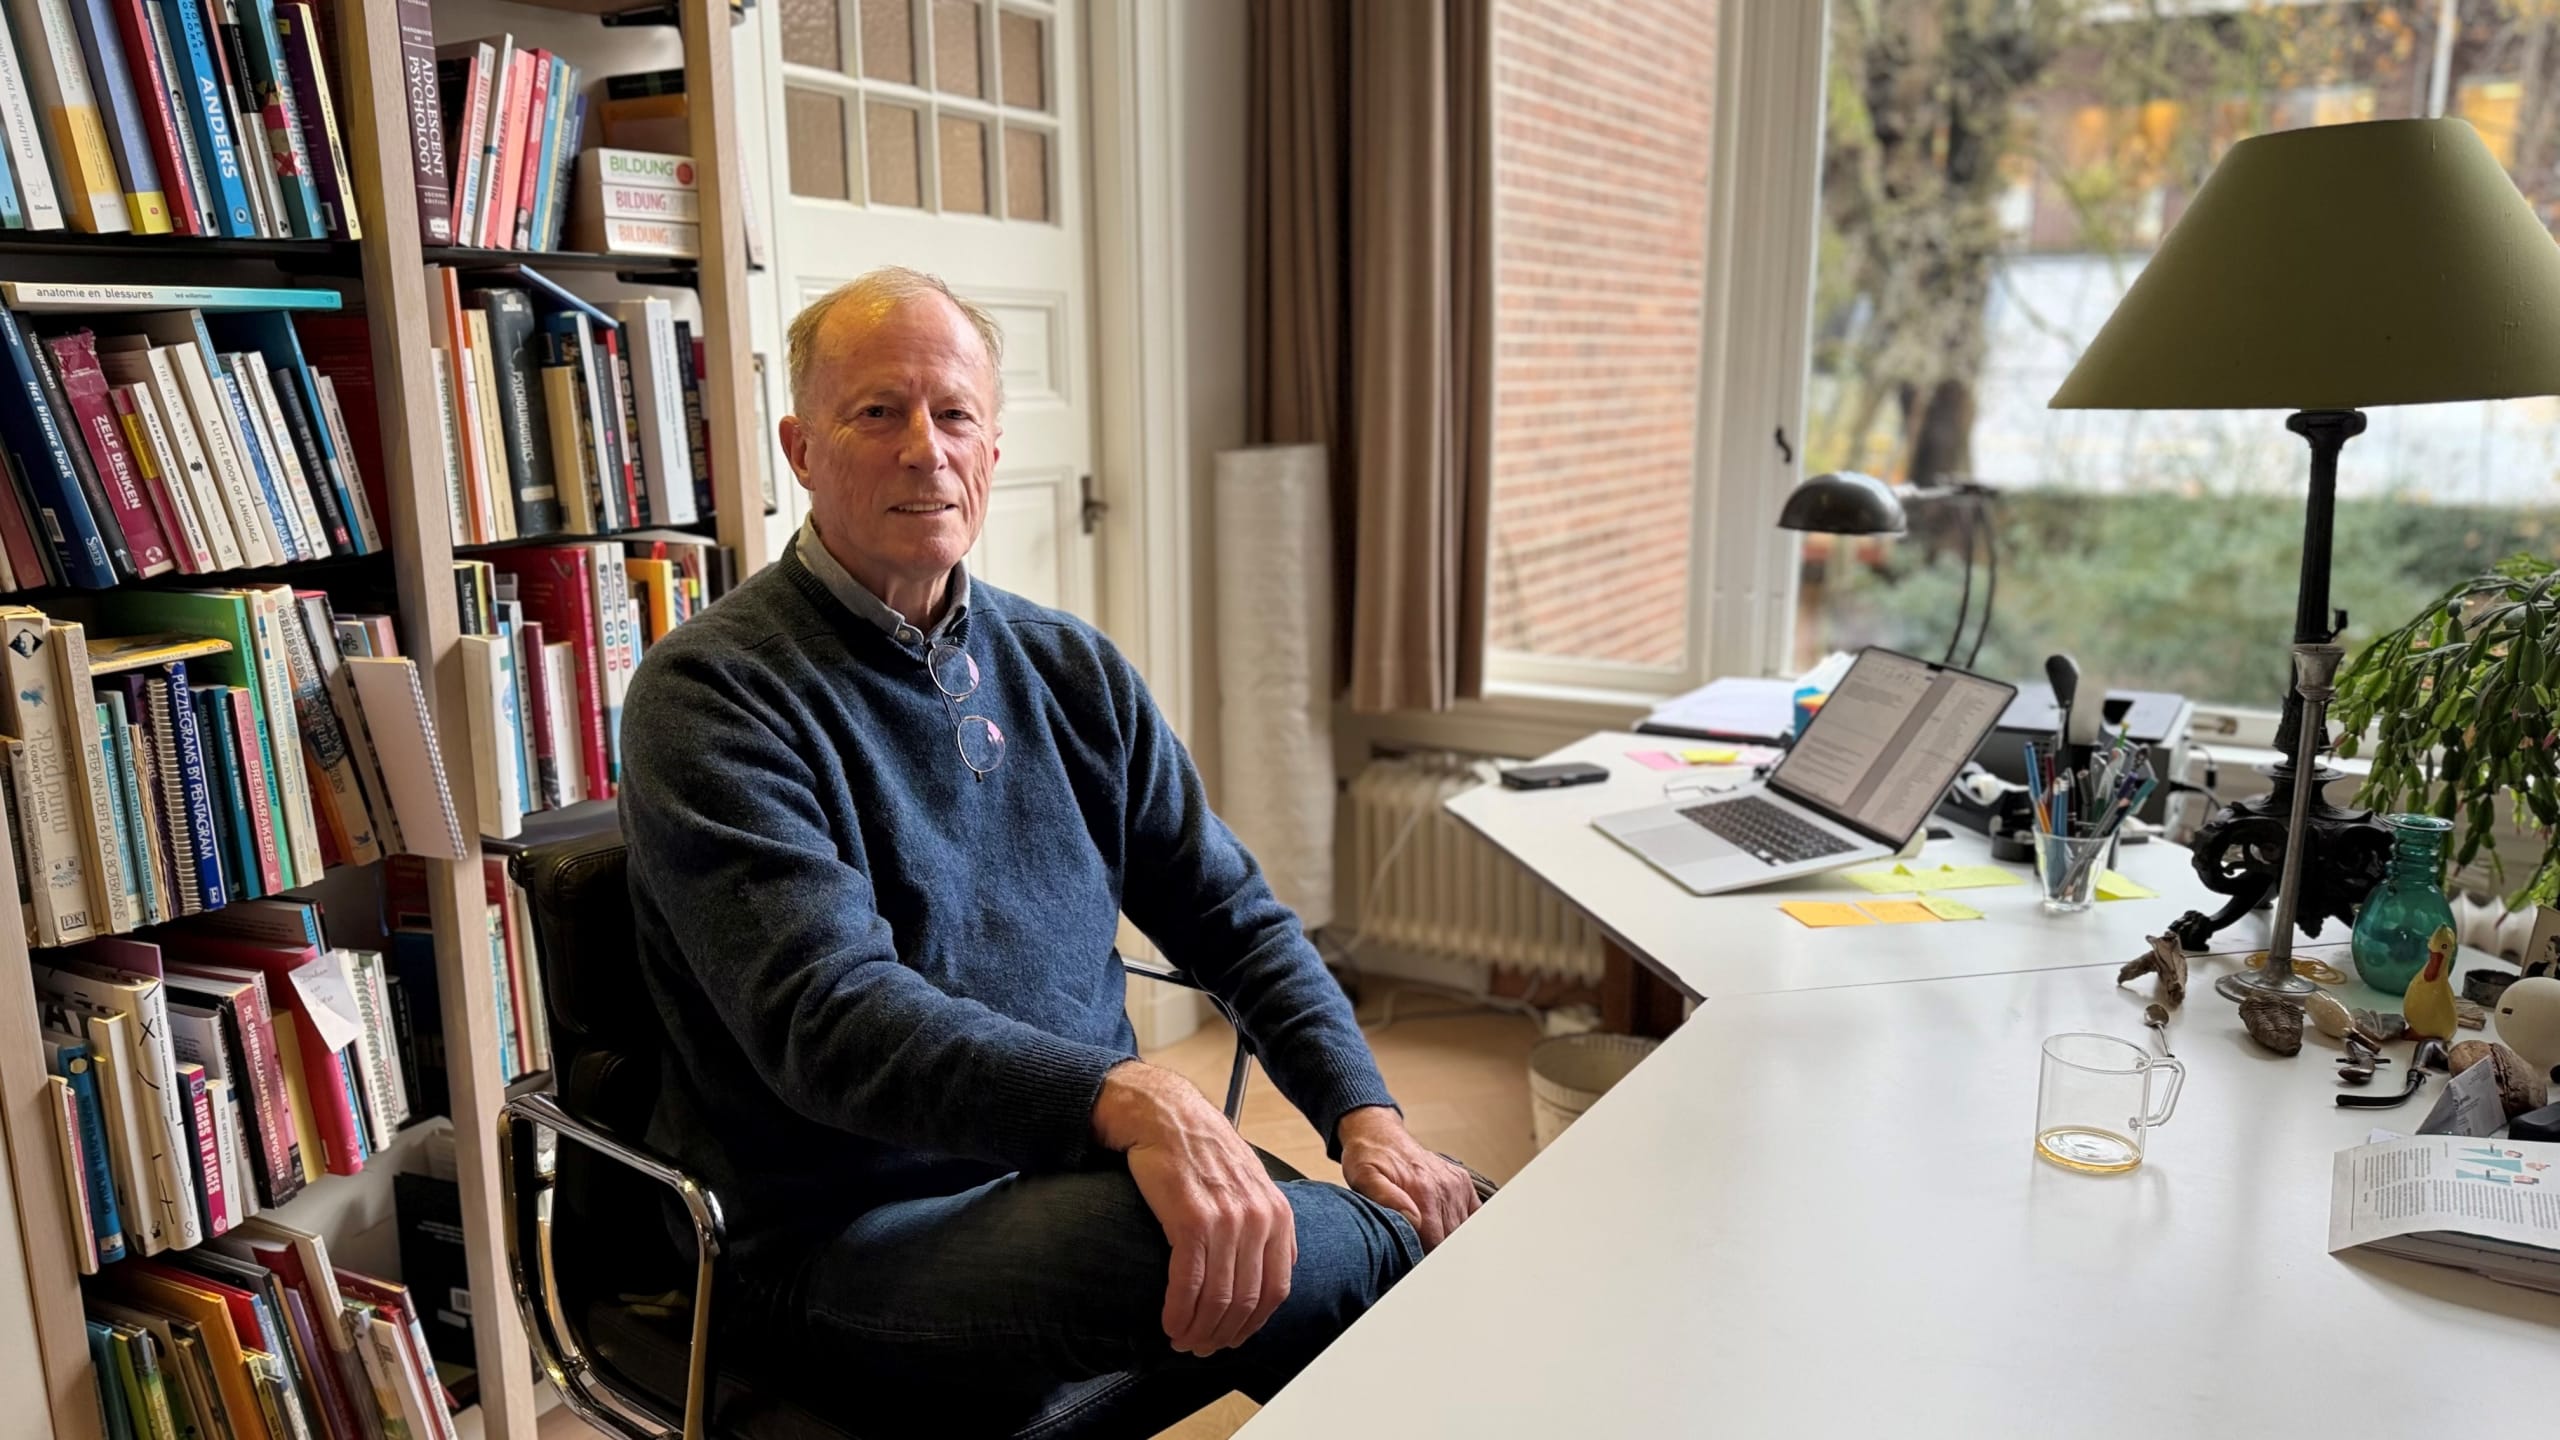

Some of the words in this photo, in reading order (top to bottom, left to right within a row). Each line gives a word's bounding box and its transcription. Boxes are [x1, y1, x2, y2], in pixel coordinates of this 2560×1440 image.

[275, 58, 289, 79] DE
[199, 76, 238, 177] ANDERS
[281, 84, 315, 185] OPVOEDERS
[411, 56, 433, 176] PSYCHOLOGY
[421, 57, 444, 178] ADOLESCENT
[609, 155, 674, 177] BILDUNG
[615, 190, 667, 211] BILDUNG
[618, 224, 669, 247] BILDUNG
[36, 287, 86, 299] anatomie
[88, 289, 102, 299] en
[104, 288, 154, 299] blessures
[27, 333, 58, 389] Toespraken
[157, 365, 170, 383] THE
[166, 389, 182, 416] BLACK
[179, 423, 193, 447] SWAN
[225, 378, 237, 391] EN
[232, 397, 247, 420] DAN
[512, 371, 533, 460] PSYCHOLINGUISTICS
[26, 381, 43, 402] Het
[35, 405, 60, 446] blauwe
[53, 450, 73, 478] boek
[212, 428, 229, 456] LITTLE
[96, 415, 118, 449] ZELF
[111, 453, 142, 508] DENKEN
[223, 459, 238, 482] BOOK
[232, 485, 243, 495] OF
[448, 457, 464, 518] SNEAKERS
[237, 498, 260, 543] LANGUAGE
[464, 583, 472, 597] The
[604, 621, 618, 671] GOED
[619, 619, 632, 669] GOED
[274, 606, 310, 682] GEHEUGEN
[309, 707, 347, 792] VERBETEREN
[171, 675, 197, 764] PUZZLEGRAMS
[257, 720, 266, 735] The
[87, 744, 101, 771] PIETER
[144, 736, 159, 778] Contract
[260, 738, 273, 768] Science
[92, 775, 105, 795] VAN
[187, 767, 200, 781] BY
[266, 770, 280, 807] Explorer
[37, 790, 49, 823] edward
[96, 798, 109, 822] DELFT
[190, 784, 213, 858] PENTAGRAM
[249, 761, 275, 862] BREINKRAKERS
[102, 836, 115, 857] JACK
[106, 860, 125, 920] BOTERMANS
[63, 914, 85, 929] DK
[243, 1006, 254, 1021] DE
